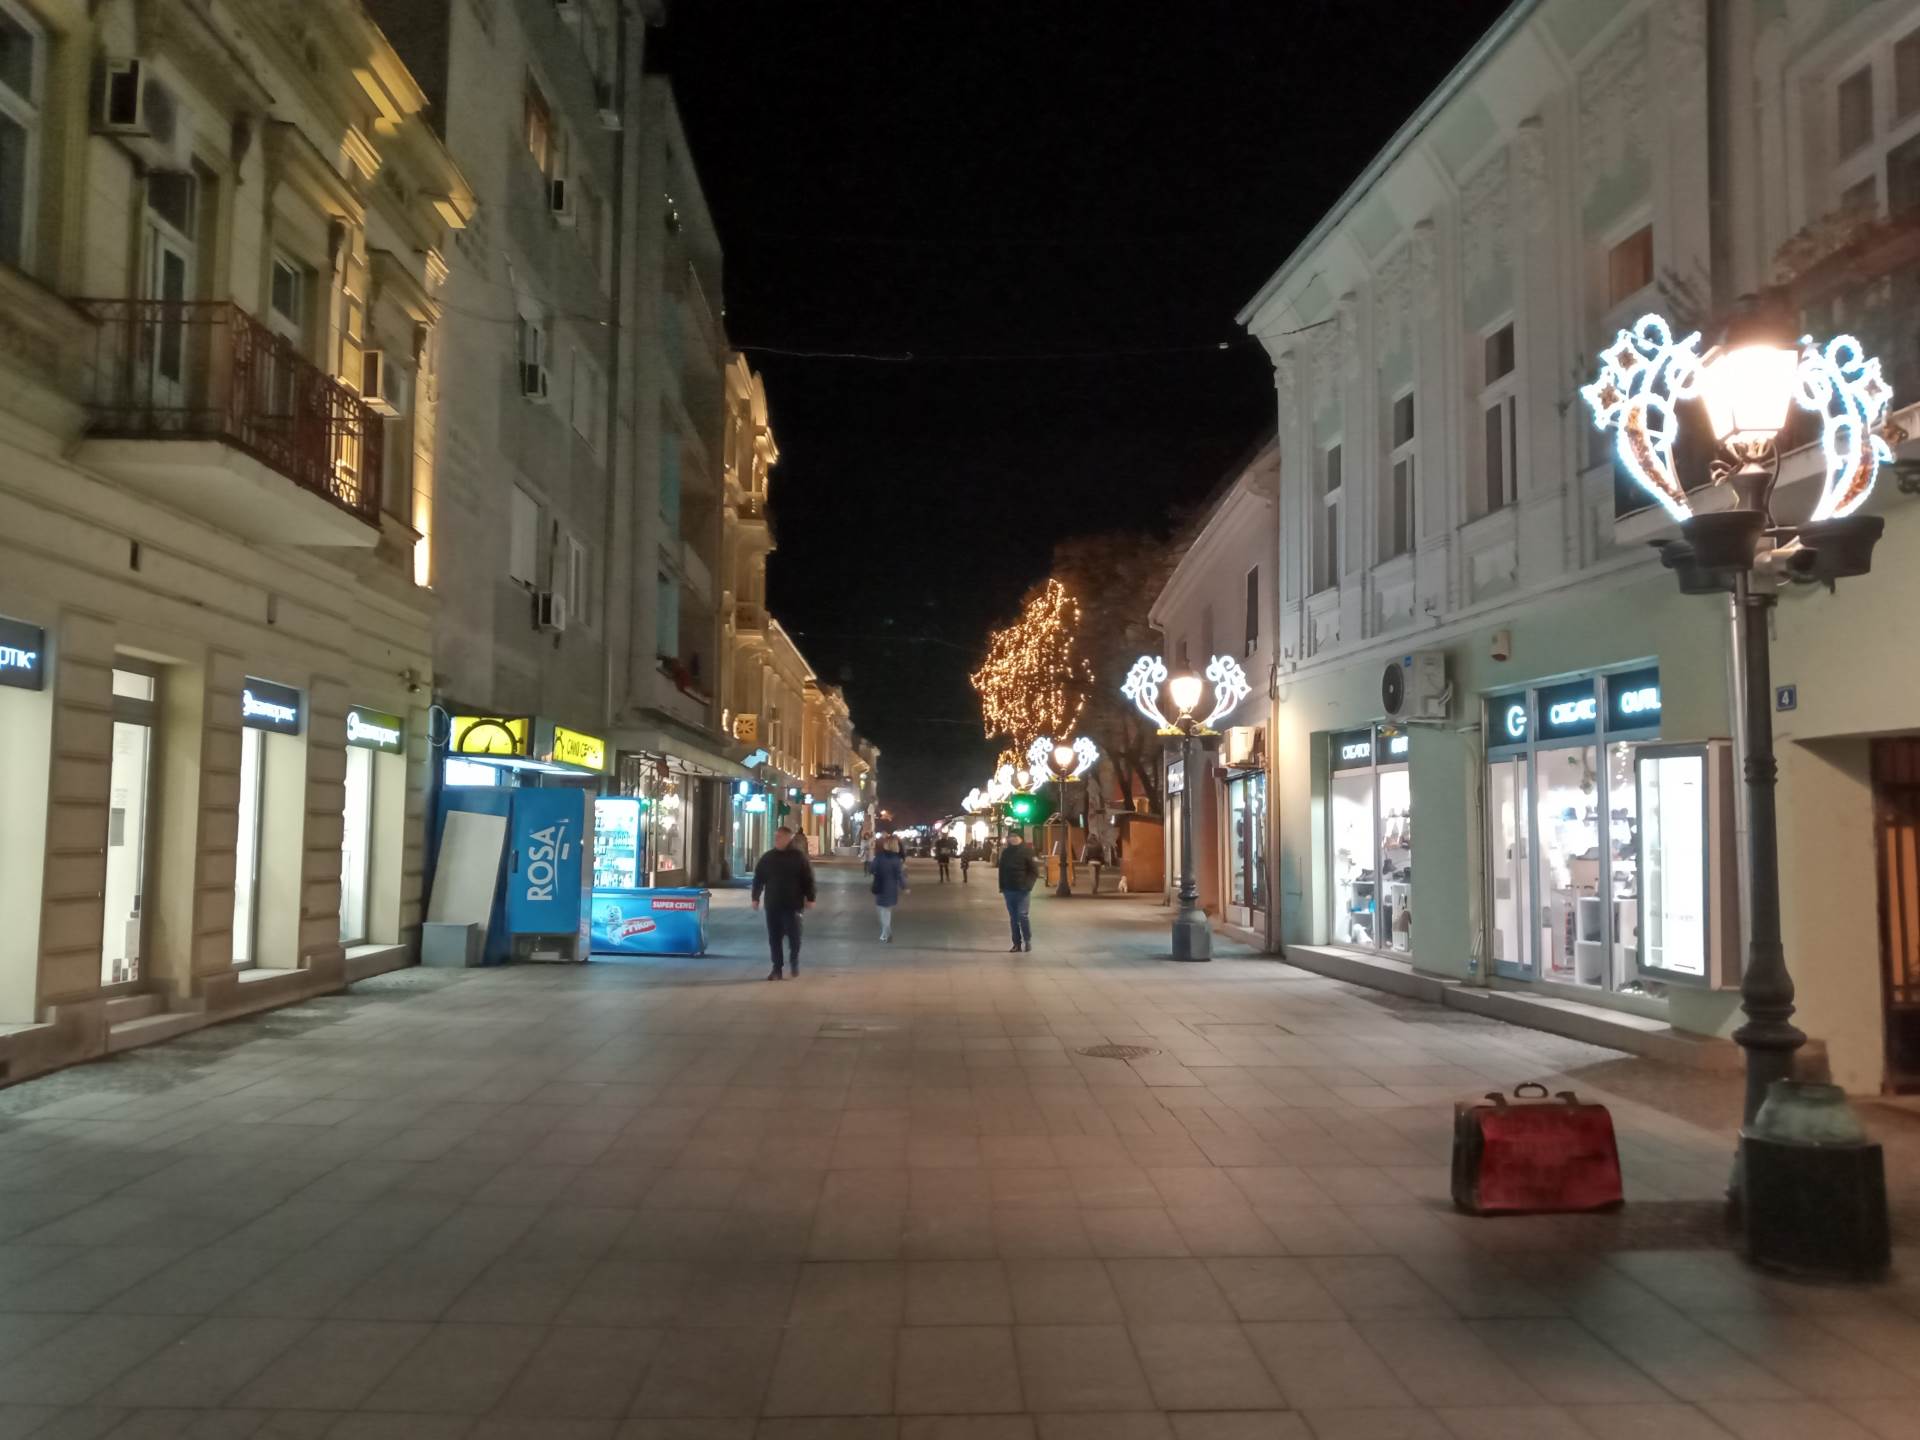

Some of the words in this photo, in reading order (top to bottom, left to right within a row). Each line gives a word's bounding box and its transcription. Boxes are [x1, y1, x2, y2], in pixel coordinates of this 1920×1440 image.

[1550, 698, 1597, 725] CREATO
[1621, 687, 1662, 714] OUTL
[1781, 690, 1790, 705] 4
[527, 825, 556, 901] ROSA
